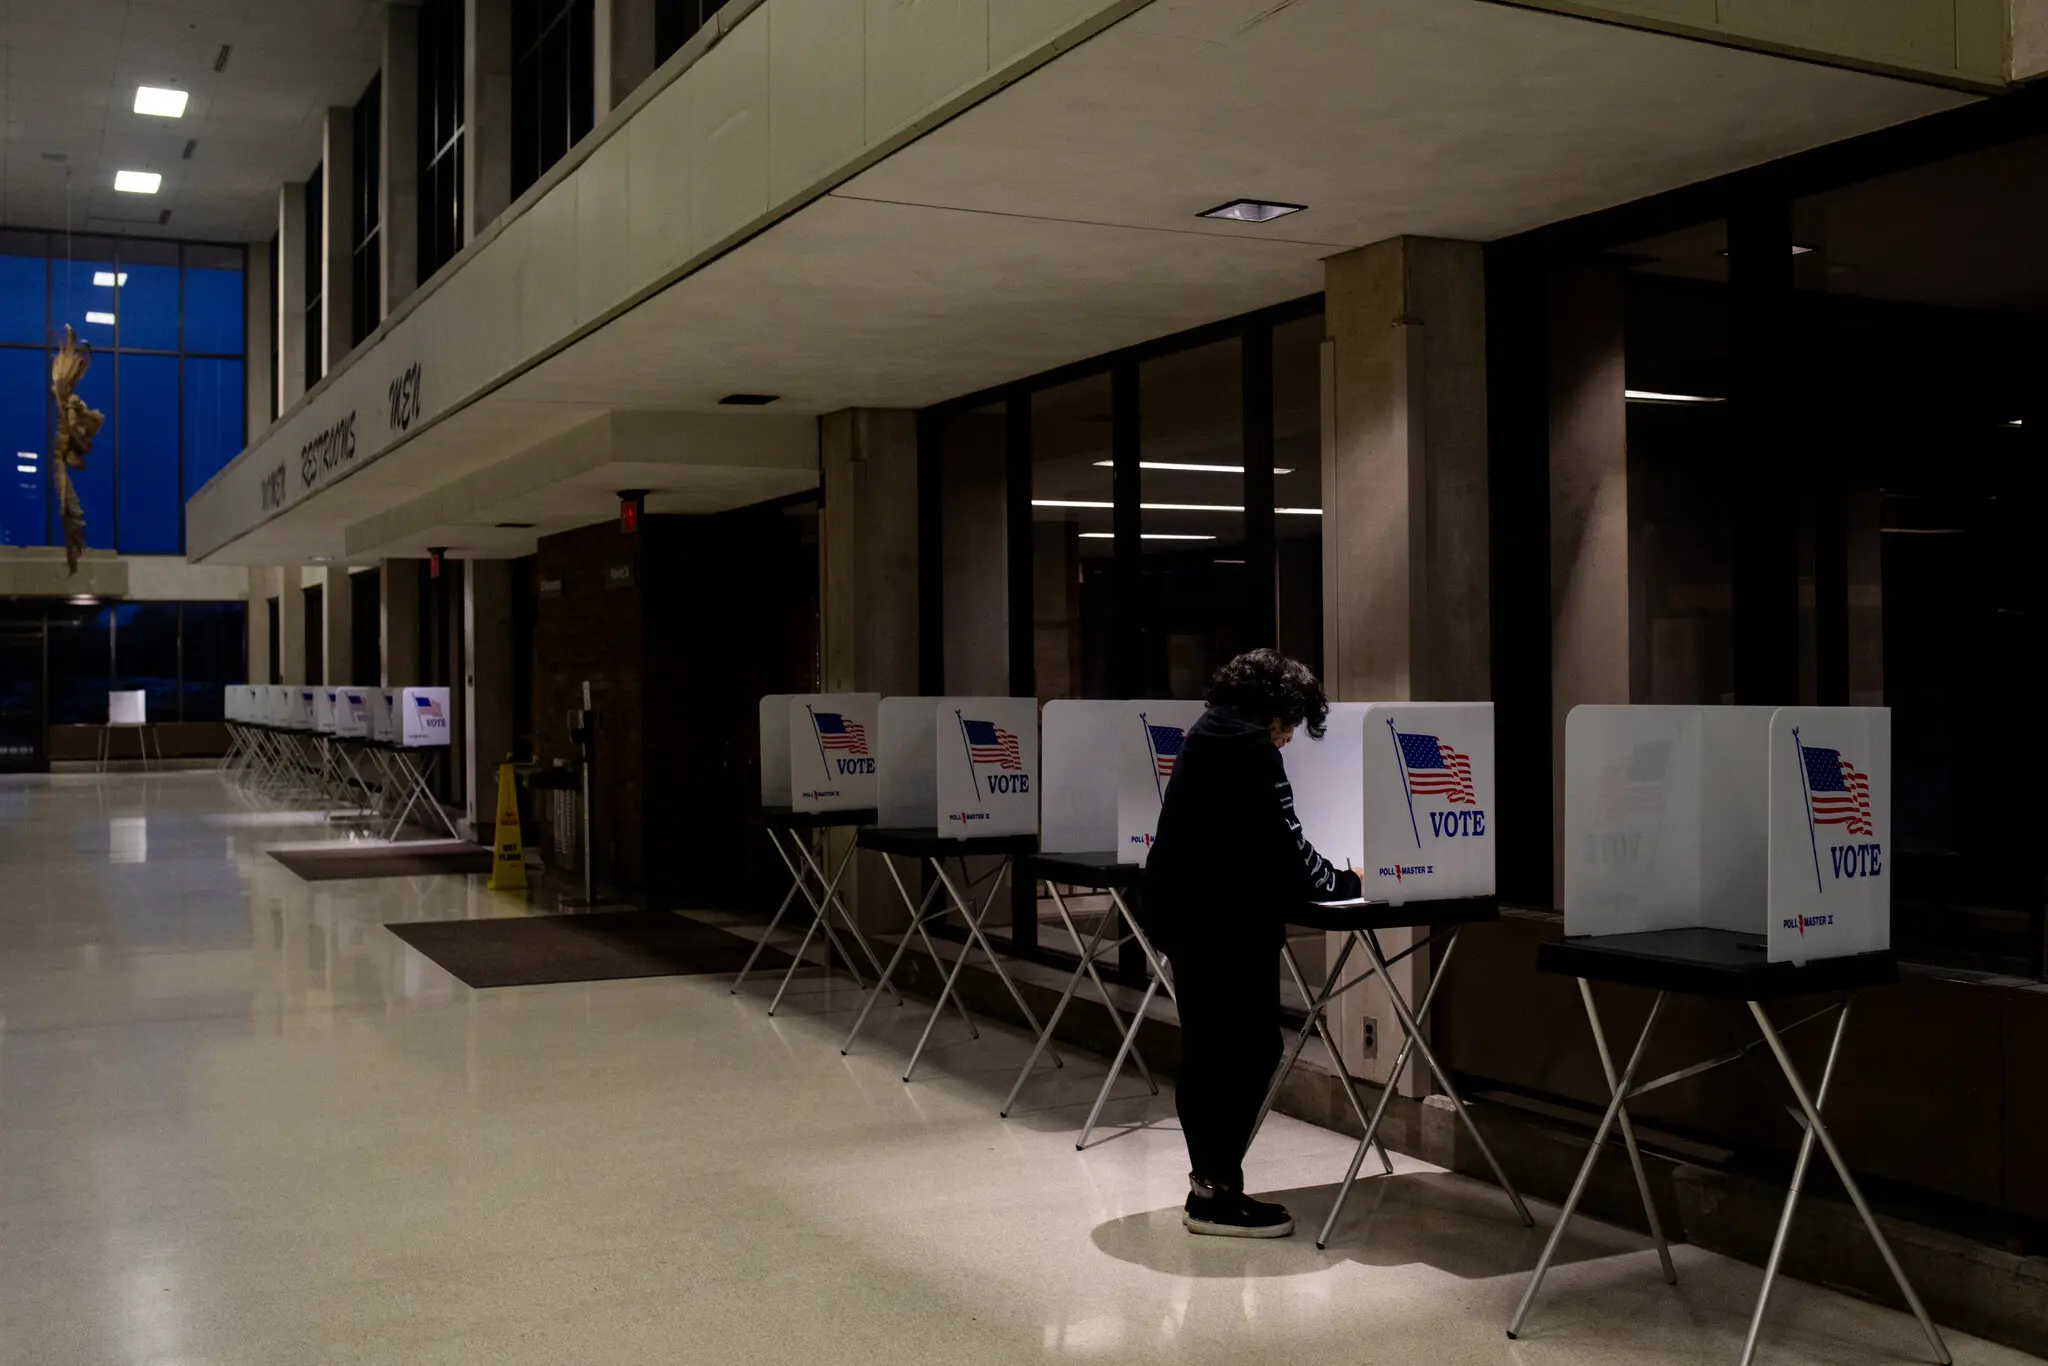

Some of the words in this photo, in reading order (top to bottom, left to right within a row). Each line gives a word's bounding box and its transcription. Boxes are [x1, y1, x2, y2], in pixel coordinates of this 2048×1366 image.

[388, 362, 422, 430] MEN
[302, 410, 356, 488] RESTROOMS
[426, 718, 446, 728] VOTE
[837, 757, 876, 775] VOTE
[987, 774, 1030, 794] VOTE
[1430, 810, 1485, 838] VOTE
[1379, 868, 1395, 876] POLL
[1402, 866, 1426, 874] MASTER
[1830, 843, 1882, 879] VOTE
[1783, 918, 1799, 929] POLL
[1804, 915, 1827, 927] MASTER
